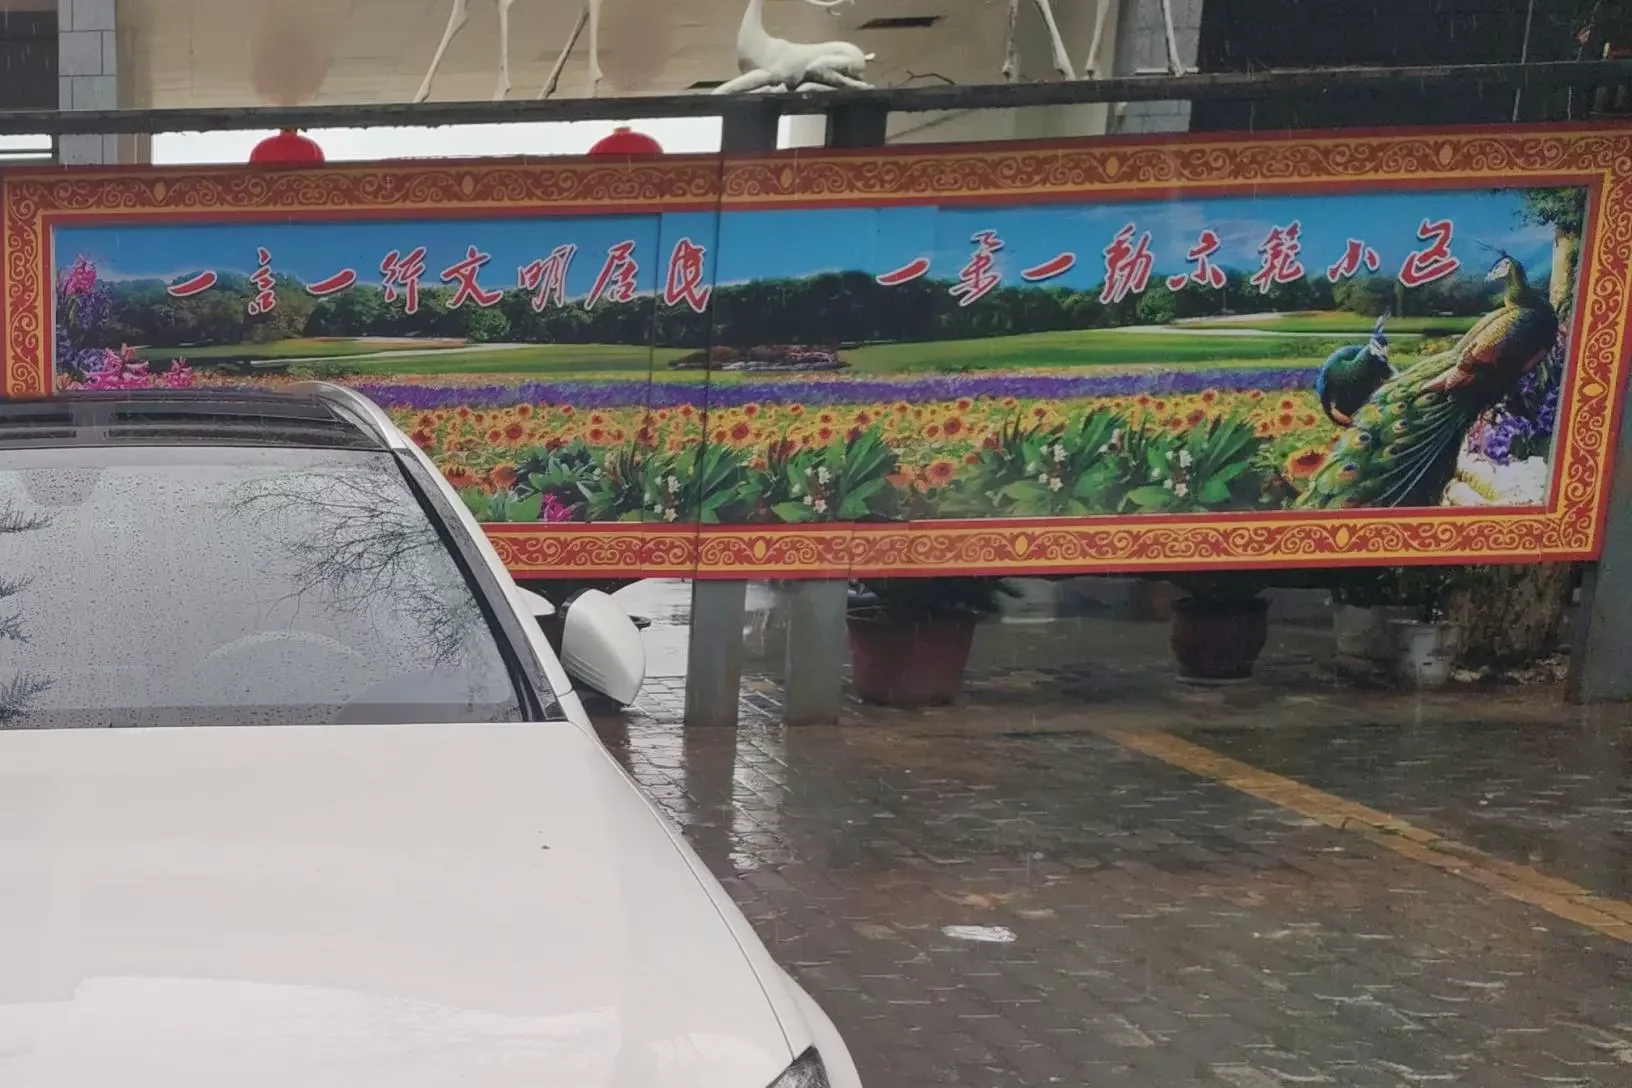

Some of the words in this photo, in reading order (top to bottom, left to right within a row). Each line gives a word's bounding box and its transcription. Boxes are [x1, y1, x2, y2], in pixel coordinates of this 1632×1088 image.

[167, 237, 711, 316] 一言一行文明居民
